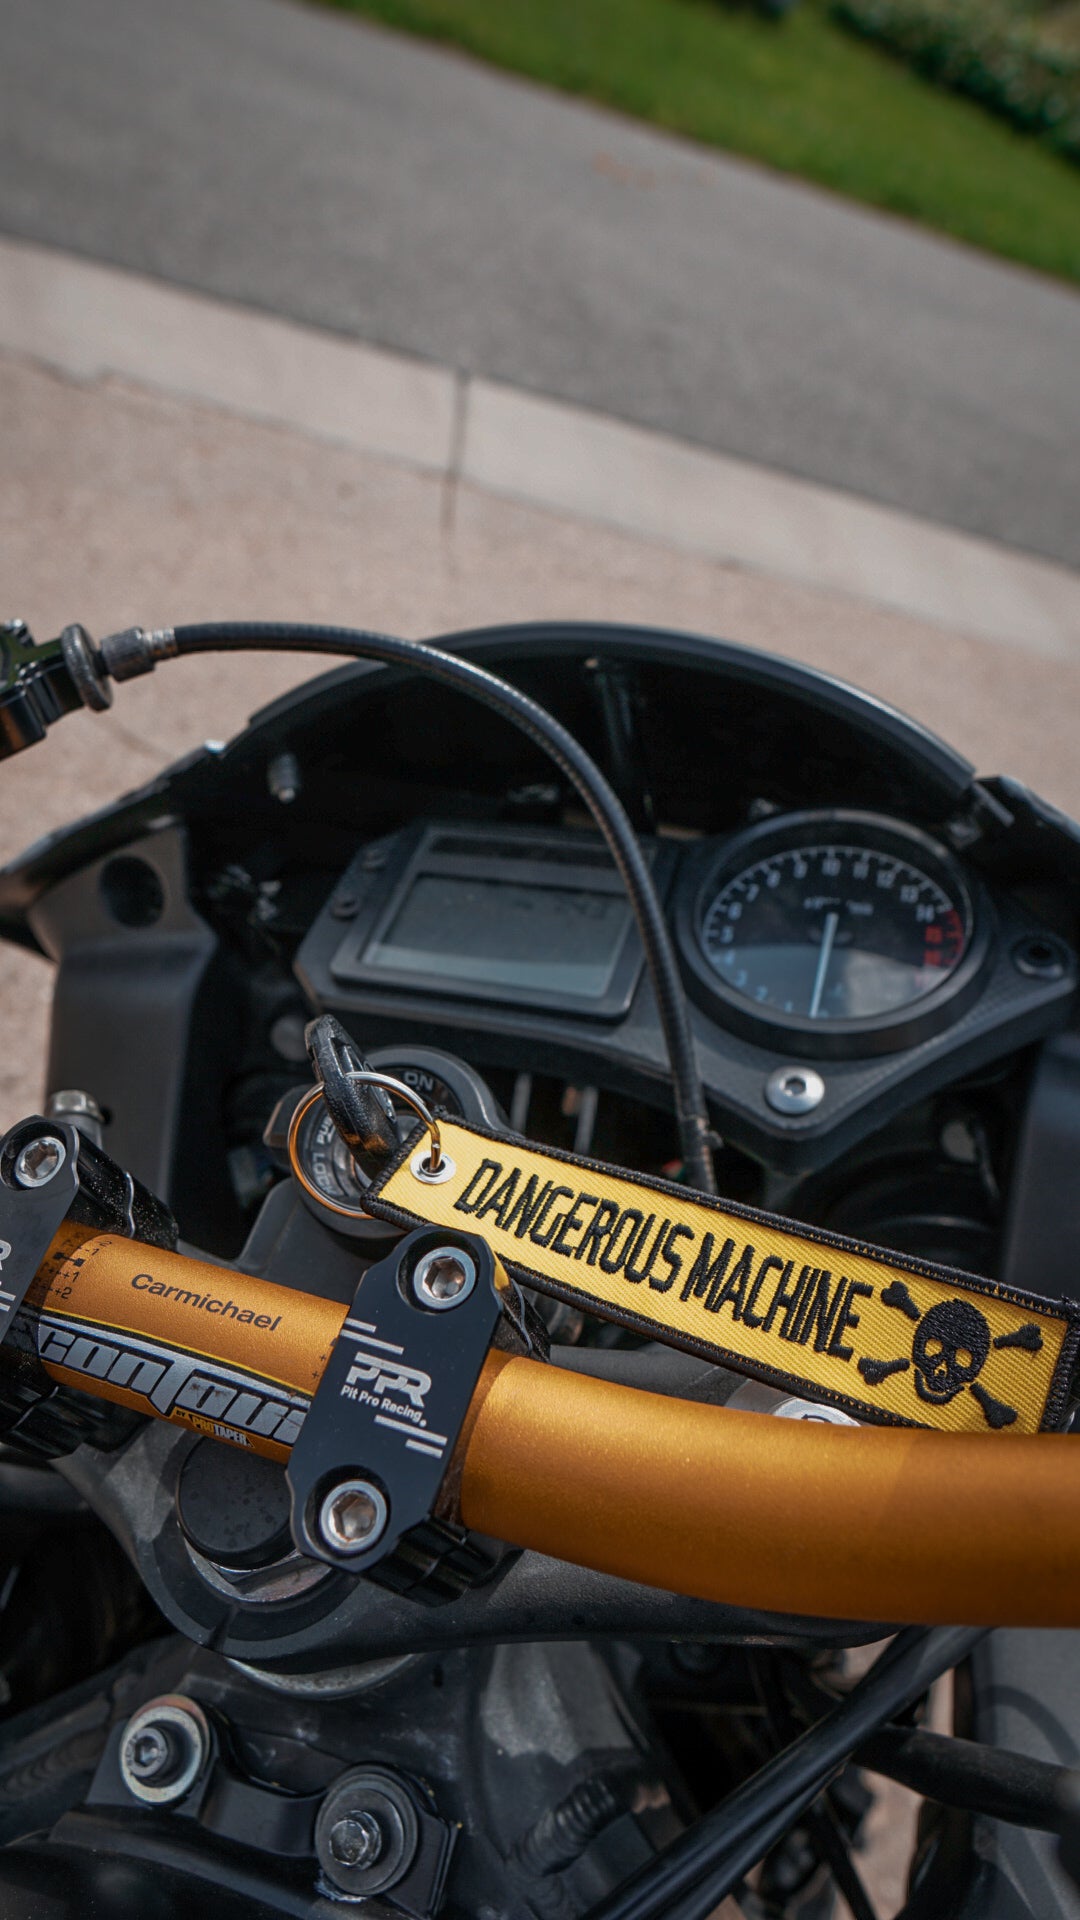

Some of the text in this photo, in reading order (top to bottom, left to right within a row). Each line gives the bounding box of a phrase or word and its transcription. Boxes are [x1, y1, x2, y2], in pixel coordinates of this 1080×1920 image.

[404, 1071, 433, 1090] ON
[316, 1113, 334, 1145] PUS
[312, 1152, 338, 1195] LOCK
[453, 1158, 873, 1361] DANGEROUS MACHINE
[131, 1273, 282, 1331] Carmichael
[340, 1384, 359, 1400] Pit
[358, 1390, 379, 1408] Pro
[345, 1351, 432, 1408] PPR
